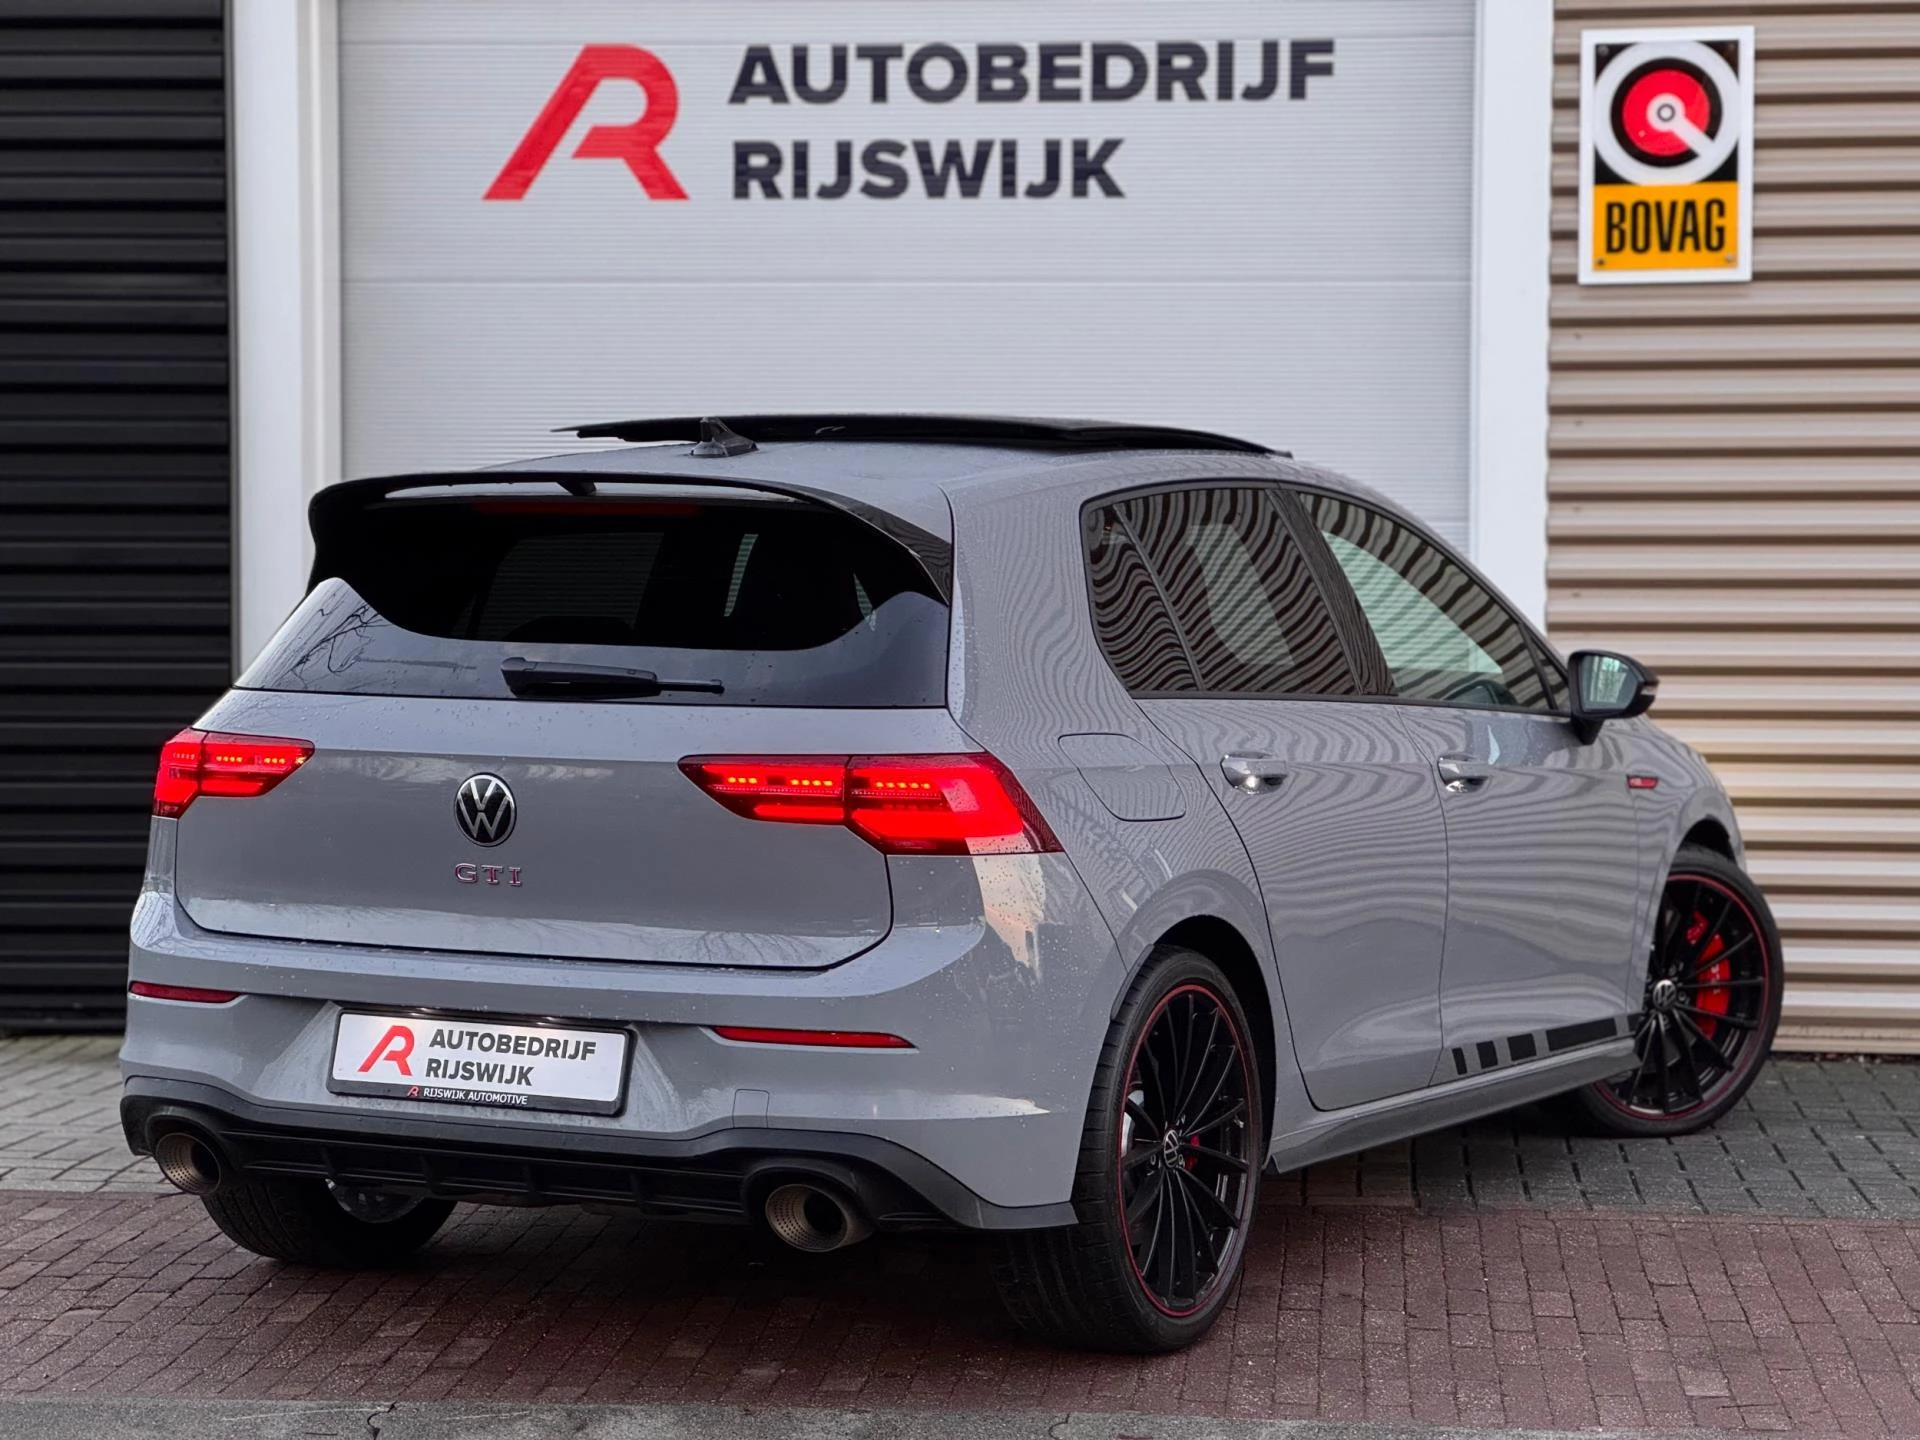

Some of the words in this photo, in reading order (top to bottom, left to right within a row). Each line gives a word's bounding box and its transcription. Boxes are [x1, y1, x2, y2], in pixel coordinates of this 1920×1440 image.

[727, 39, 1335, 104] AUTOBEDRIJF
[731, 138, 1126, 200] RIJSWIJK
[1605, 198, 1726, 255] BOVAG
[454, 862, 522, 886] GTI
[428, 1028, 597, 1062] AUTOBEDRIJF
[425, 1057, 535, 1087] RIJSWIJK
[423, 1087, 467, 1100] RIJSWIJK
[467, 1090, 529, 1105] AUTOMOTIVE
